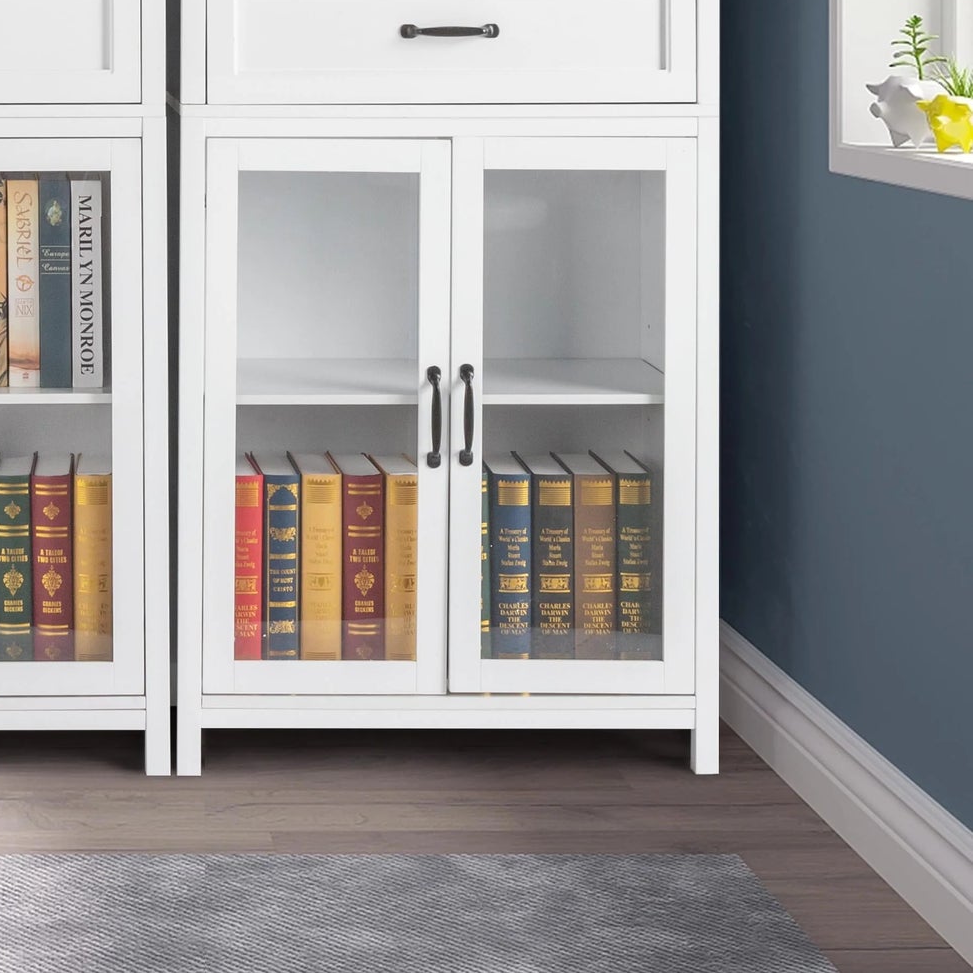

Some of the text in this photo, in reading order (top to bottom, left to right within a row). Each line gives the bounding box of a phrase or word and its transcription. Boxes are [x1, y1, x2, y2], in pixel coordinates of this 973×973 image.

[42, 248, 69, 258] Europe
[42, 263, 69, 271] Canvas
[78, 195, 94, 374] MARILYN MONROE
